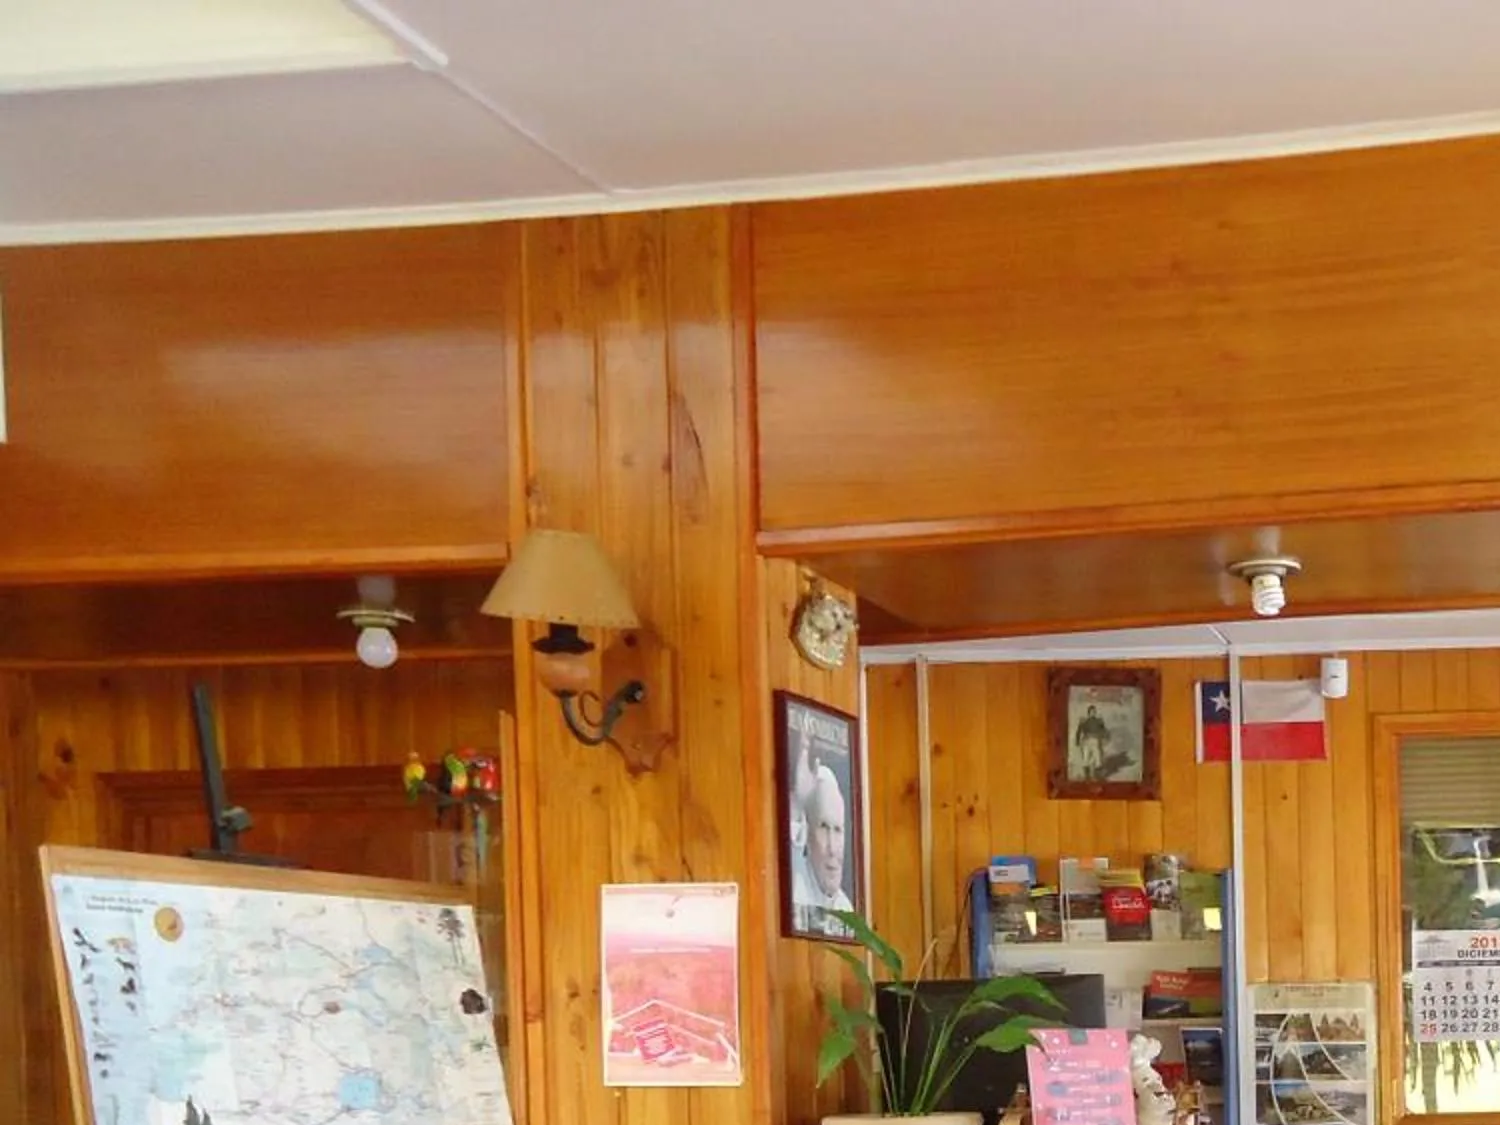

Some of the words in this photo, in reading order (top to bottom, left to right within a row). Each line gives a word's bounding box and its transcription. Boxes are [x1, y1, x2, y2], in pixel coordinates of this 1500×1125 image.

[1421, 996, 1435, 1006] 11
[1442, 995, 1457, 1005] 12
[1462, 995, 1478, 1004] 13
[1483, 995, 1499, 1004] 14
[1420, 1010, 1437, 1020] 18
[1442, 1009, 1458, 1019] 19
[1461, 1009, 1478, 1018] 20
[1482, 1008, 1498, 1018] 21
[1420, 1023, 1437, 1034] 25
[1441, 1023, 1458, 1033] 26
[1462, 1023, 1478, 1033] 27
[1482, 1022, 1499, 1032] 28
